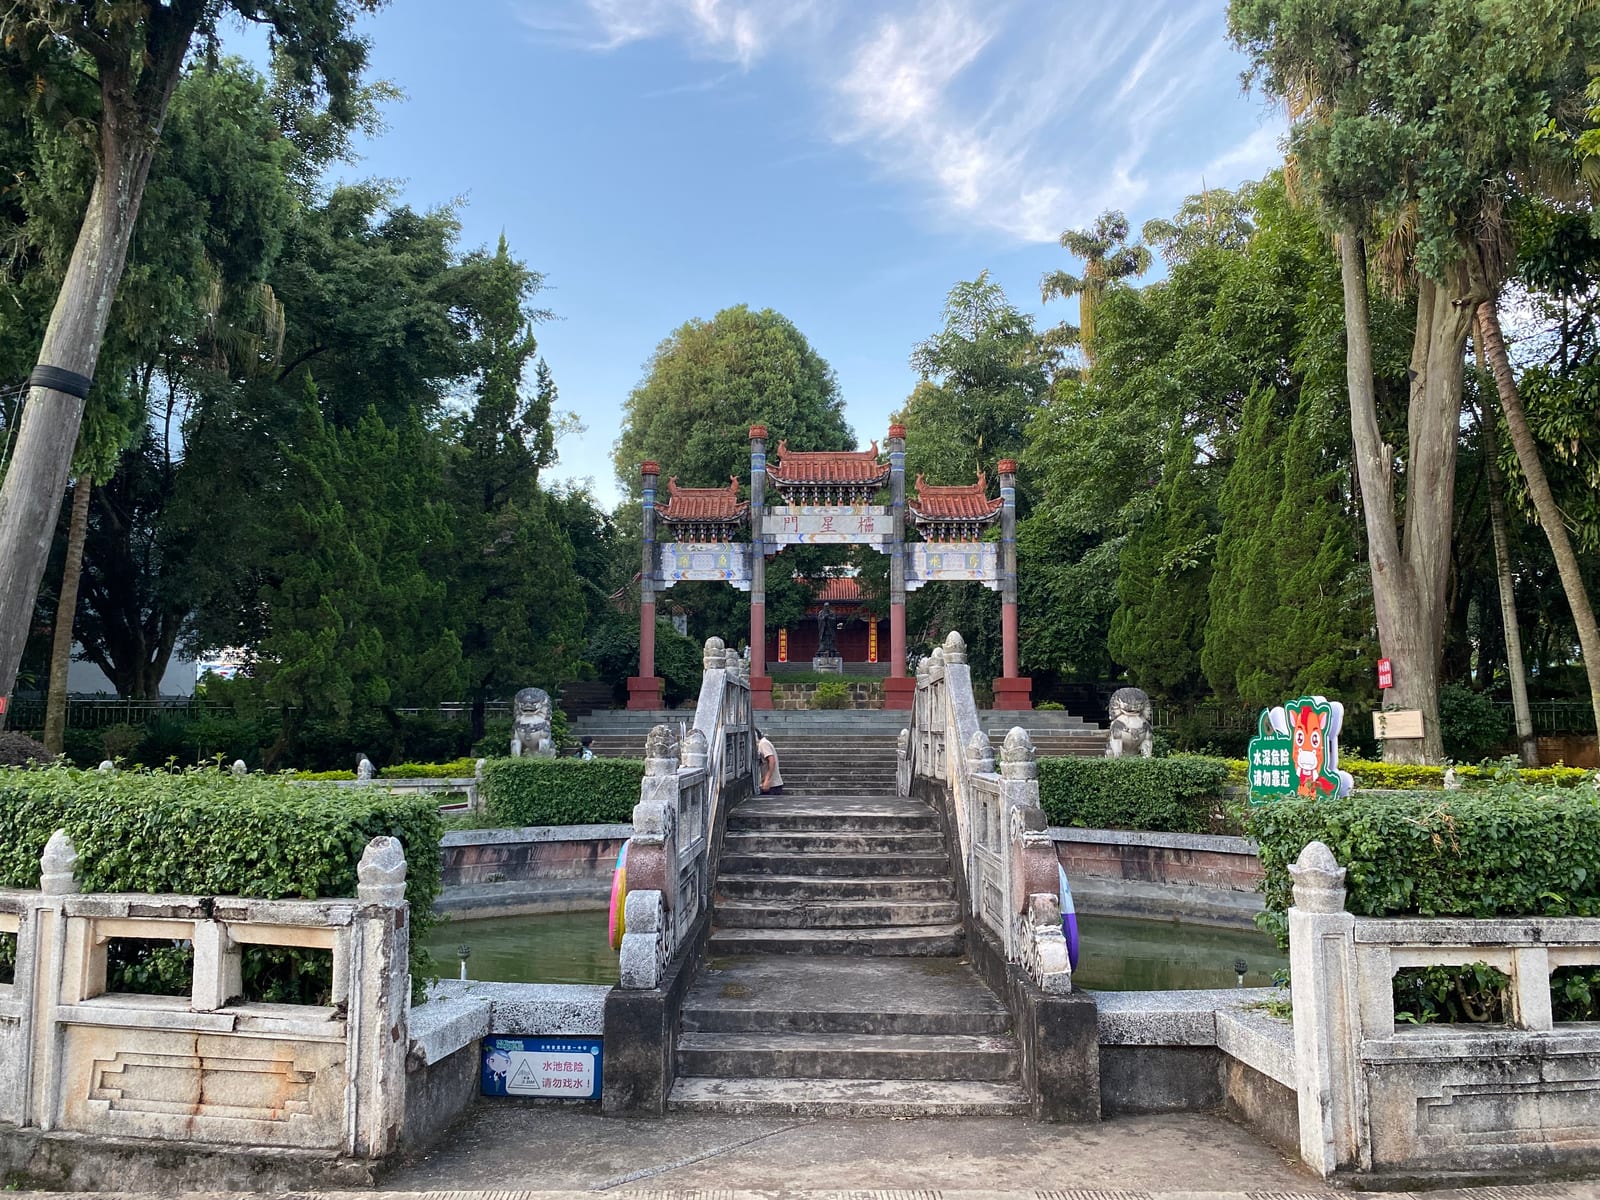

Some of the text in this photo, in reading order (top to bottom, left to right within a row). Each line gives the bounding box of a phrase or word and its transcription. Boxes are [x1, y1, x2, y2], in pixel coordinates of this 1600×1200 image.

[1253, 749, 1290, 767] 水深危险
[1253, 770, 1290, 788] 请勿靠近
